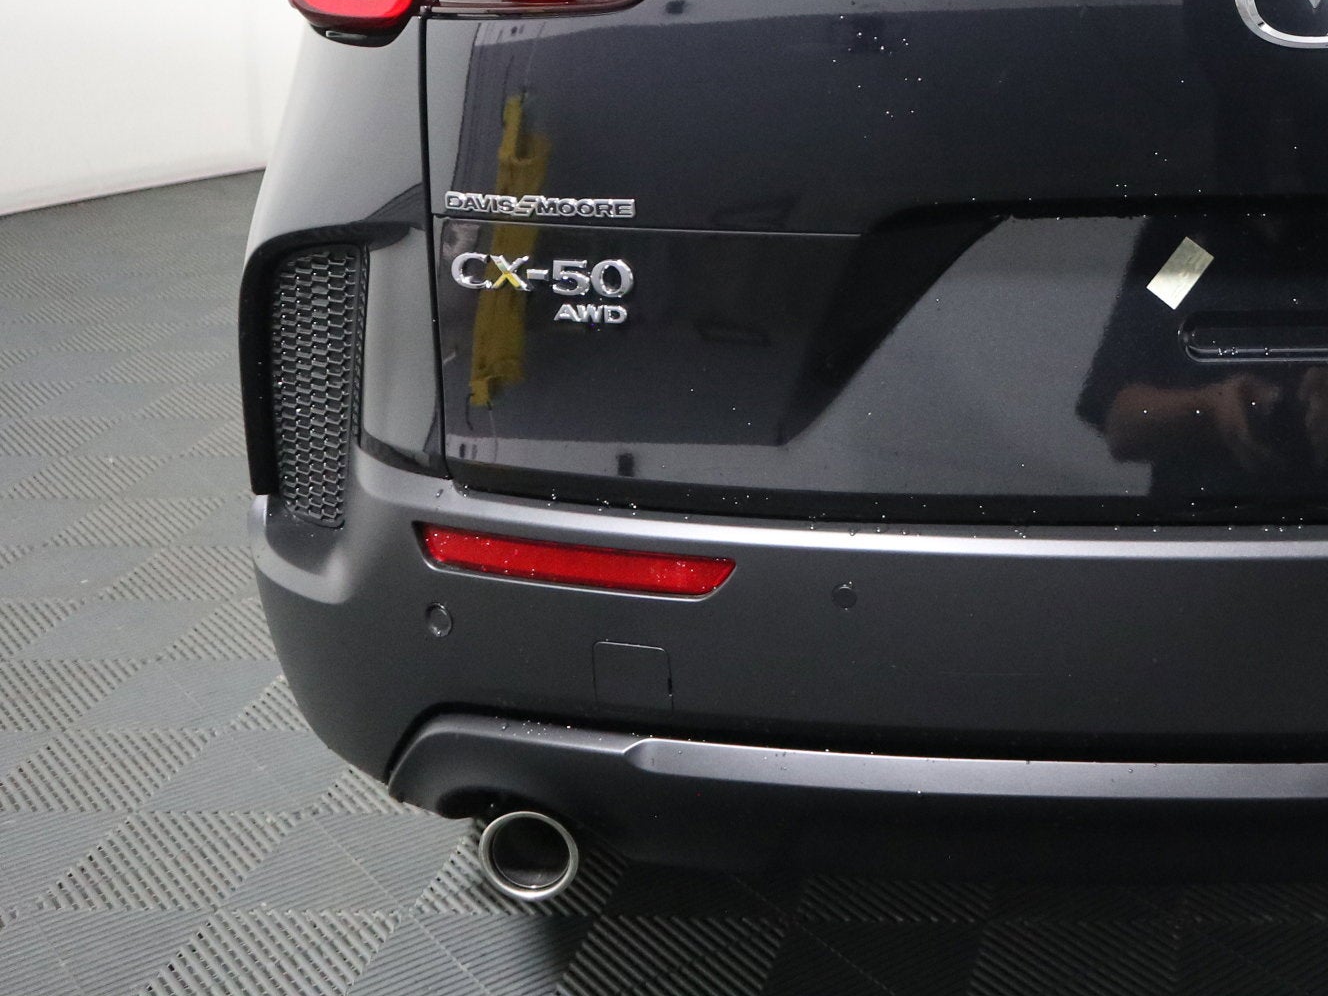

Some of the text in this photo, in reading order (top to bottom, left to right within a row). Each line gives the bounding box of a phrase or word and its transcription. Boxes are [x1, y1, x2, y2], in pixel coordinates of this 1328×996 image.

[445, 191, 636, 218] DAVIS MOORE
[451, 252, 634, 298] CX-50
[554, 303, 628, 324] AWD
